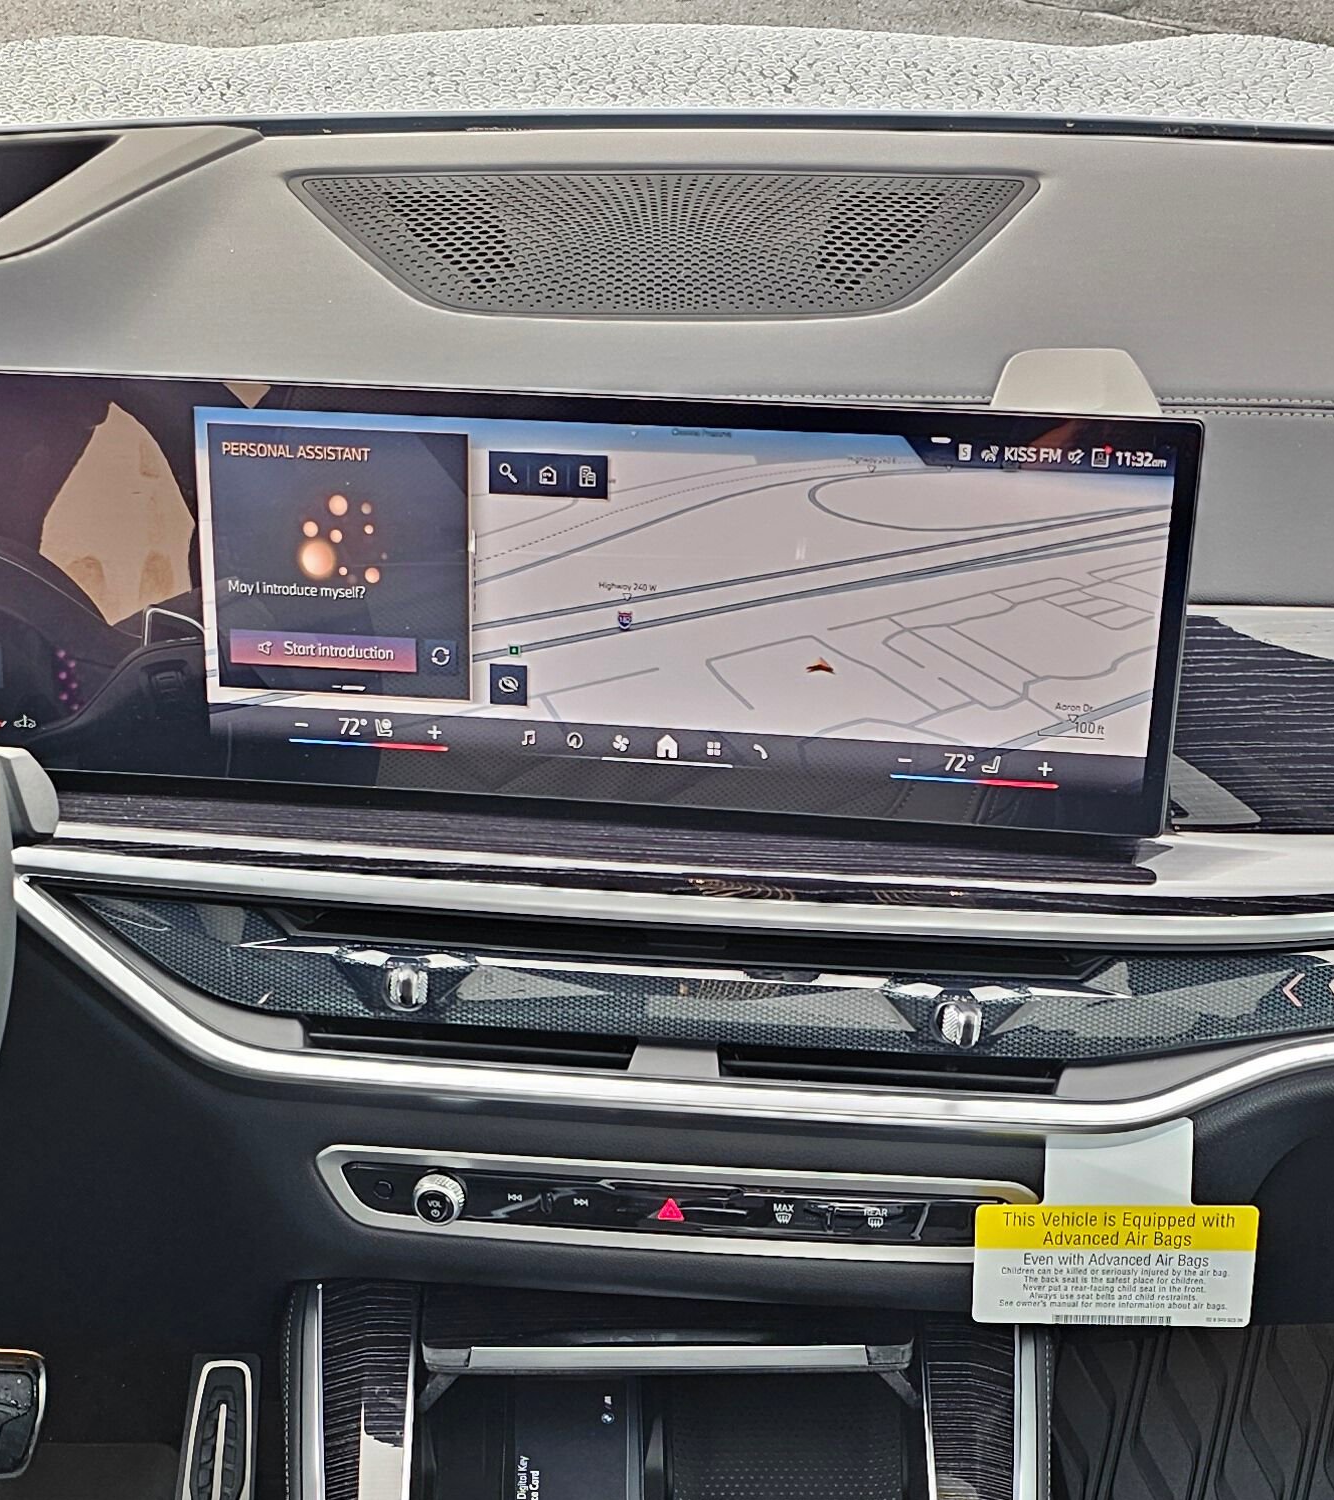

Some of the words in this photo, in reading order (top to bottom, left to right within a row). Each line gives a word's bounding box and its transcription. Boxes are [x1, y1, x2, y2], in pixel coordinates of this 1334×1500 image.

[221, 442, 294, 458] PERSONAL
[297, 445, 371, 462] ASSISTANT
[1004, 446, 1037, 463] KISS
[1039, 448, 1062, 464] FM
[1116, 451, 1167, 469] 11:32am
[228, 580, 254, 596] May
[256, 581, 260, 590] I
[262, 582, 318, 597] introduce
[320, 586, 366, 600] myself?
[598, 582, 632, 591] Highway
[633, 583, 647, 591] 240
[283, 640, 316, 656] Start
[318, 643, 394, 660] introduction
[1055, 702, 1079, 712] Aaron
[1074, 722, 1095, 735] 100
[1097, 724, 1105, 735] ft
[427, 1200, 442, 1208] VOL
[773, 1203, 794, 1213] MAX
[864, 1208, 888, 1217] REAR
[1003, 1212, 1035, 1226] This
[1041, 1212, 1098, 1227] Vehicle
[1103, 1213, 1116, 1227] is
[1122, 1212, 1196, 1229] Equipped
[1202, 1213, 1235, 1228] with
[1043, 1231, 1119, 1246] Advanced
[1125, 1231, 1148, 1246] Air
[1154, 1231, 1192, 1249] Bags
[1023, 1253, 1053, 1266] Even
[1058, 1253, 1084, 1266] with
[1088, 1253, 1151, 1266] Advanced
[1155, 1254, 1174, 1266] Air
[1177, 1254, 1209, 1269] Bags
[1001, 1267, 1035, 1275] Children
[1054, 1267, 1063, 1275] be
[1101, 1268, 1138, 1276] seriously
[1140, 1268, 1169, 1277] injured
[1171, 1269, 1181, 1277] by
[1133, 1277, 1154, 1285] place
[1171, 1277, 1206, 1285] children.
[1029, 1292, 1057, 1300] Always
[1071, 1285, 1114, 1293] rear-facing
[1118, 1301, 1165, 1309] information
[517, 1455, 529, 1471] Key
[517, 1472, 528, 1499] Digital
[529, 1471, 539, 1490] Card
